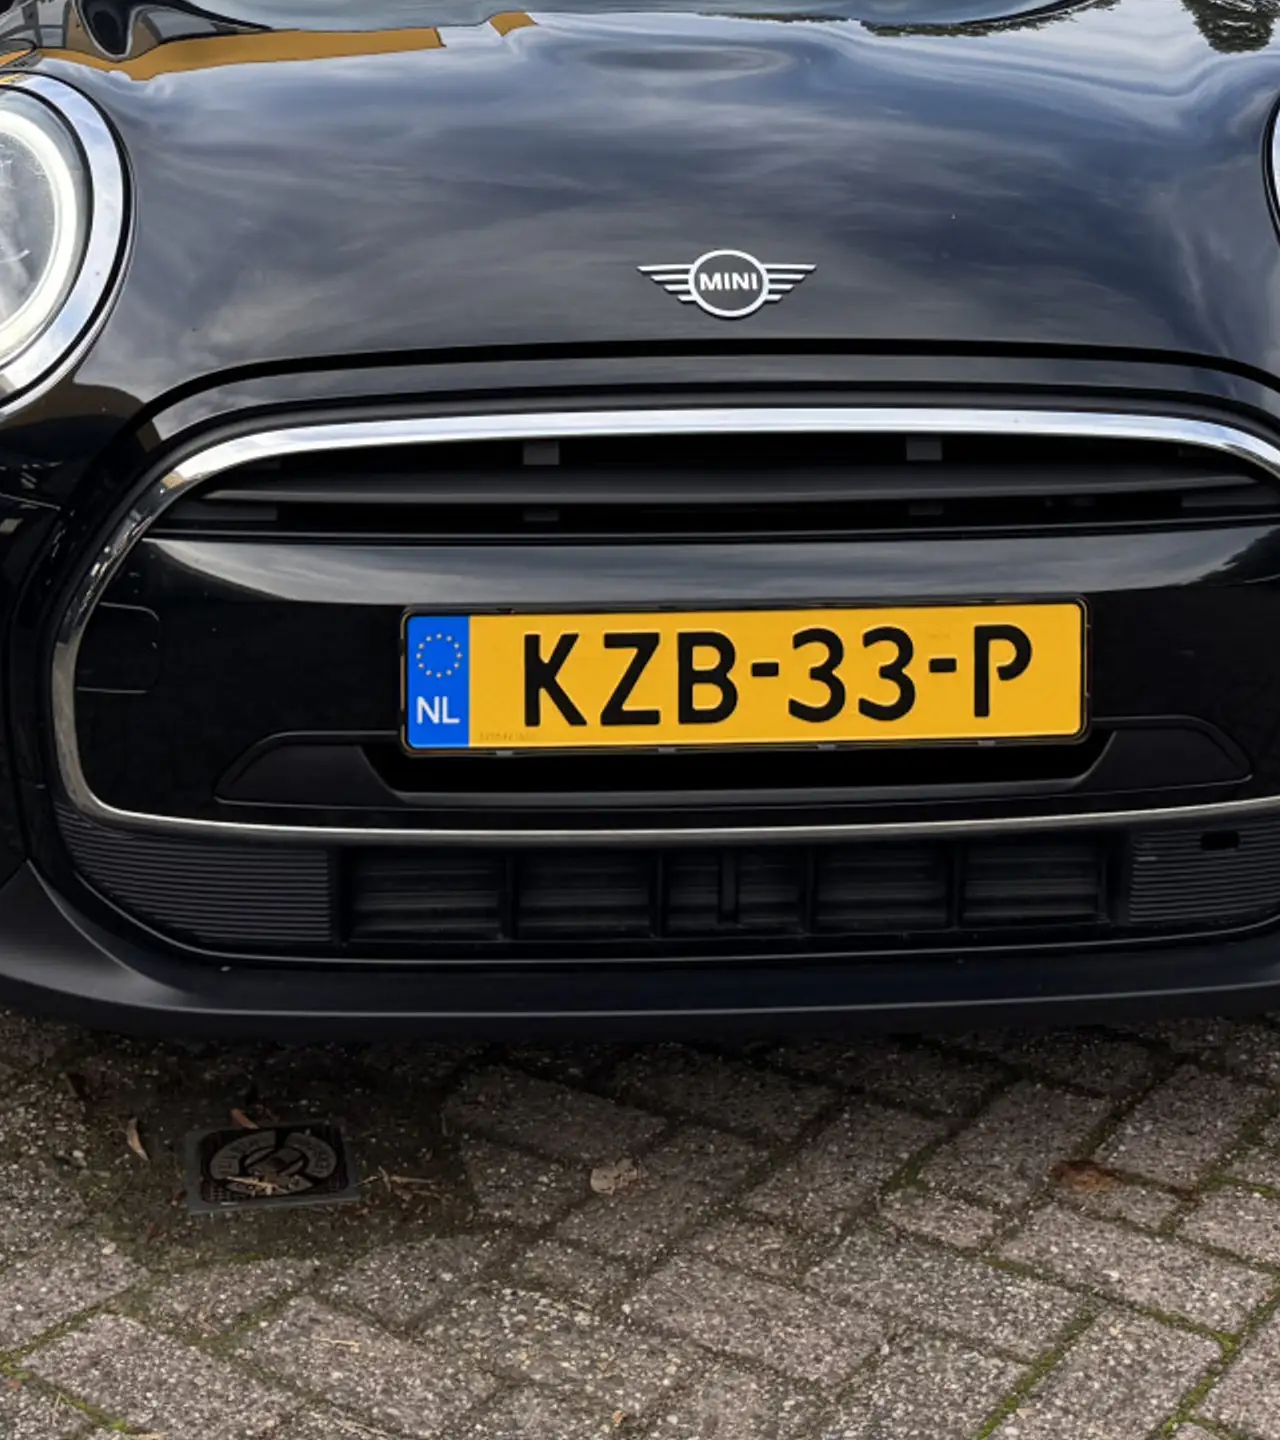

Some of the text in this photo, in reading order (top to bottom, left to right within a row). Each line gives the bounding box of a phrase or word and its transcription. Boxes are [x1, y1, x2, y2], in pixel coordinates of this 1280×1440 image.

[699, 271, 759, 291] MINI
[522, 623, 1033, 728] KZB-33-P
[416, 696, 461, 725] NL
